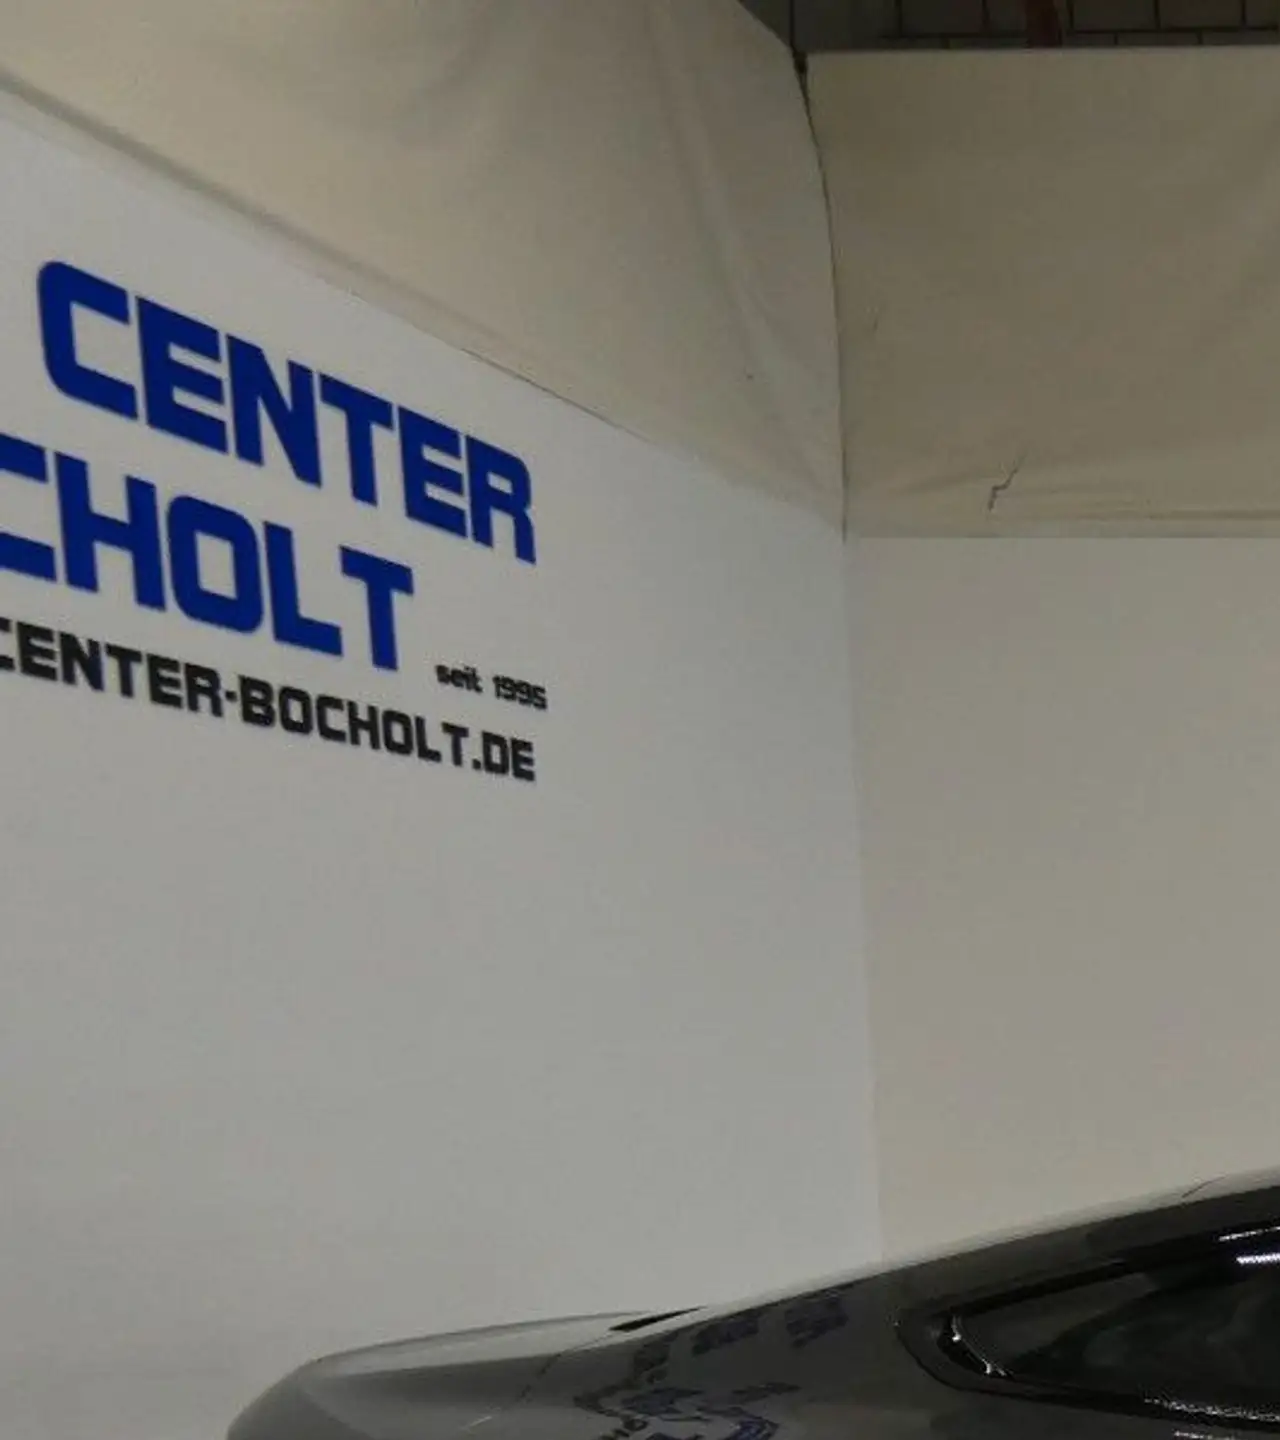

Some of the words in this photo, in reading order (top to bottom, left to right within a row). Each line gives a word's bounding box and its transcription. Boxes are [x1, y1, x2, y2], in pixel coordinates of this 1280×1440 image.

[37, 260, 537, 565] CENTER
[436, 664, 483, 693] seit
[492, 675, 548, 710] 1995
